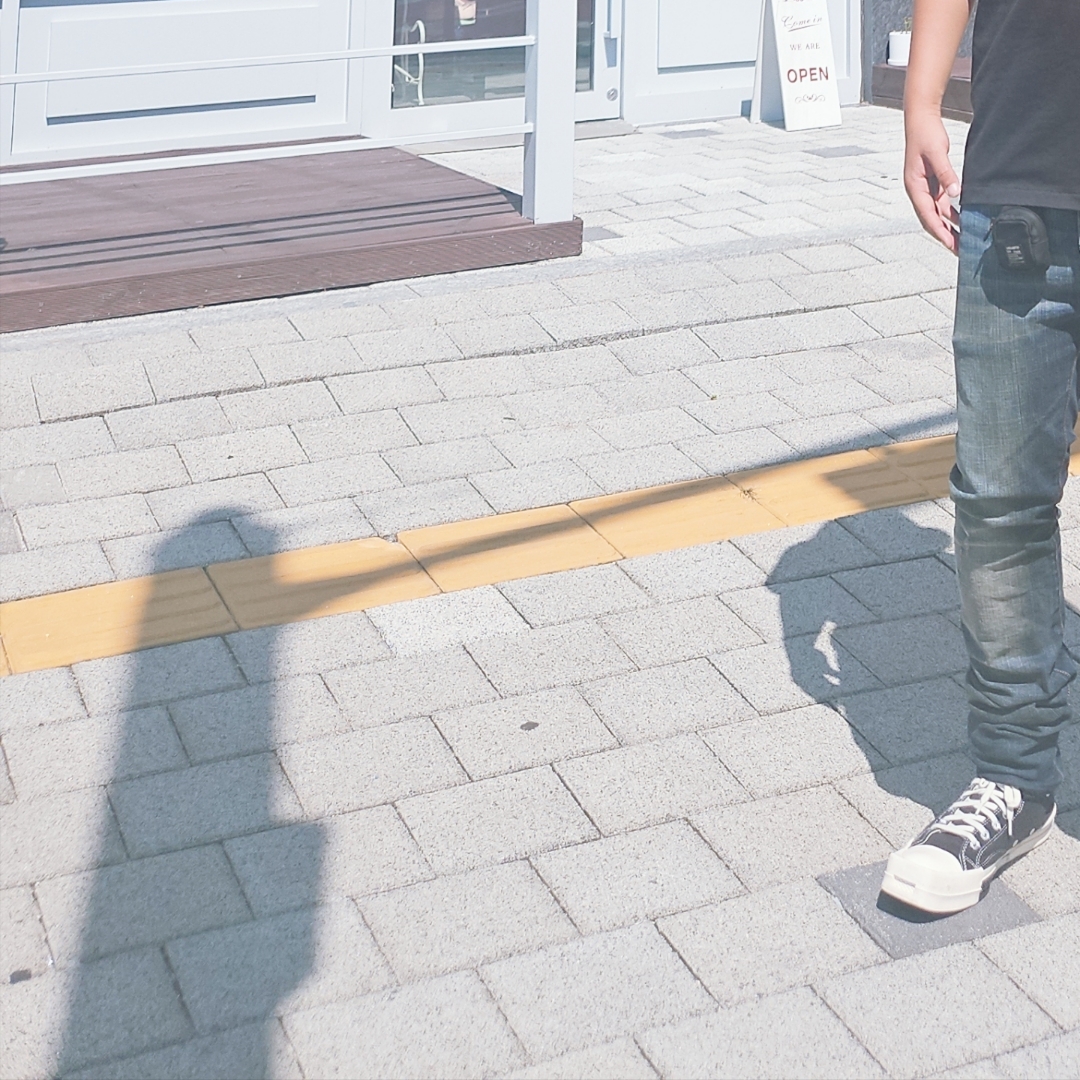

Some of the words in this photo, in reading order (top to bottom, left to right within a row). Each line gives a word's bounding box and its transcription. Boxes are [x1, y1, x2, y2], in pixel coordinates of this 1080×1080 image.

[789, 43, 802, 51] WE
[805, 42, 821, 50] ARE
[787, 66, 829, 84] OPEN
